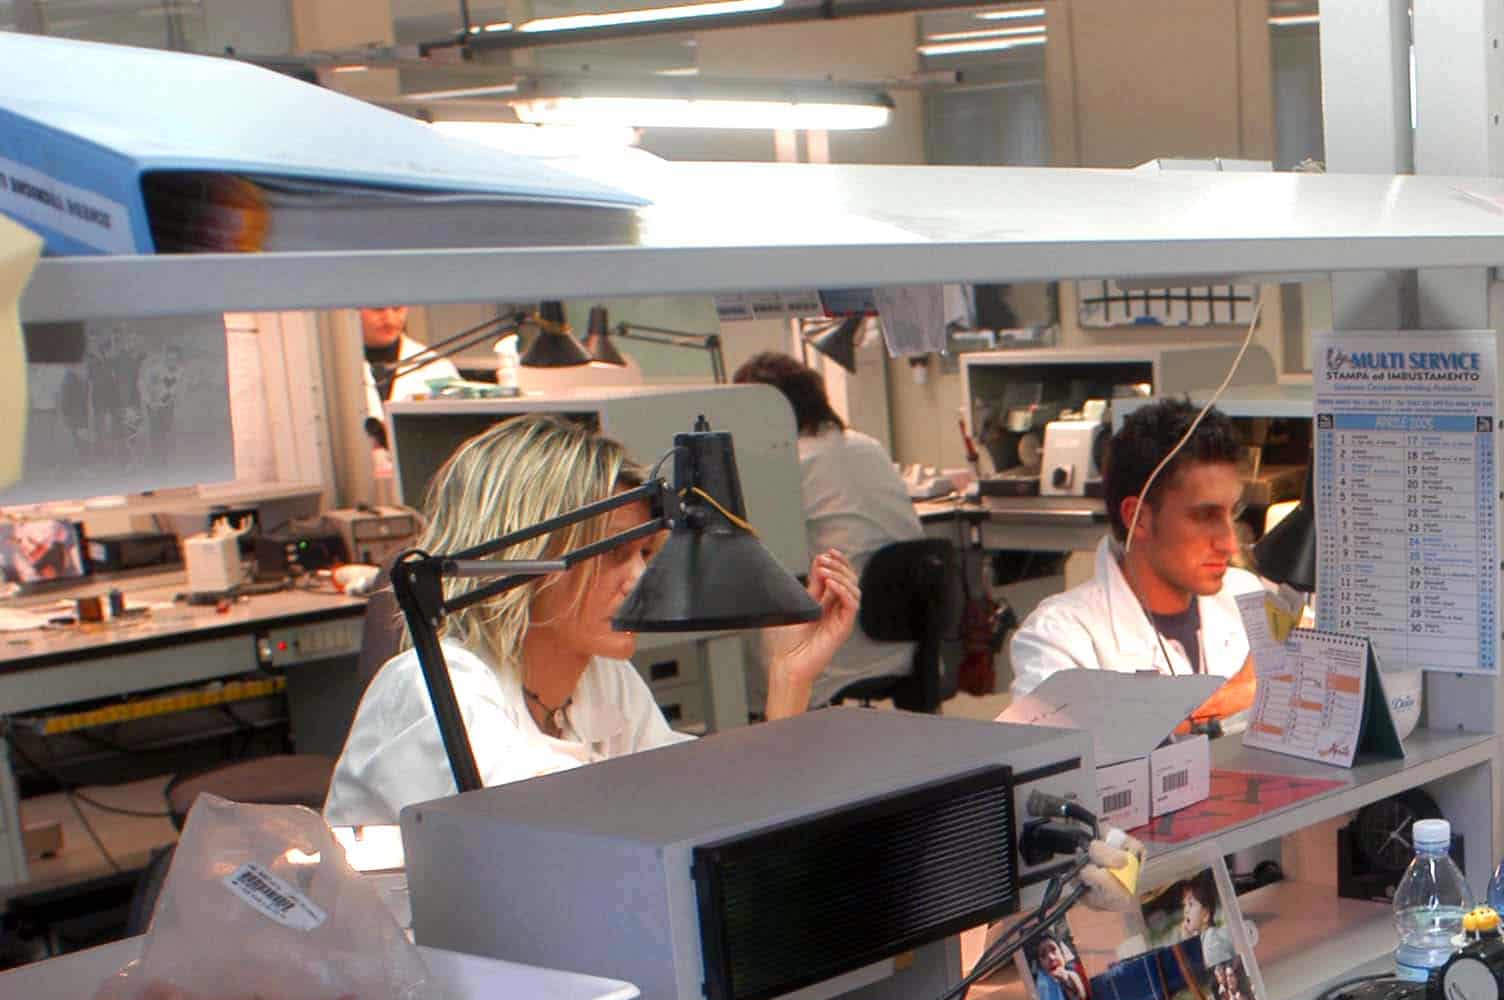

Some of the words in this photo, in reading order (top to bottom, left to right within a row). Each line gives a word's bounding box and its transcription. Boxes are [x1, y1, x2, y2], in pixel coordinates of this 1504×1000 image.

[1351, 352, 1405, 369] MULTI
[1408, 352, 1481, 370] SERVICE
[1326, 371, 1369, 381] STAMPA
[1387, 371, 1481, 382] IMBUSTAMENTO
